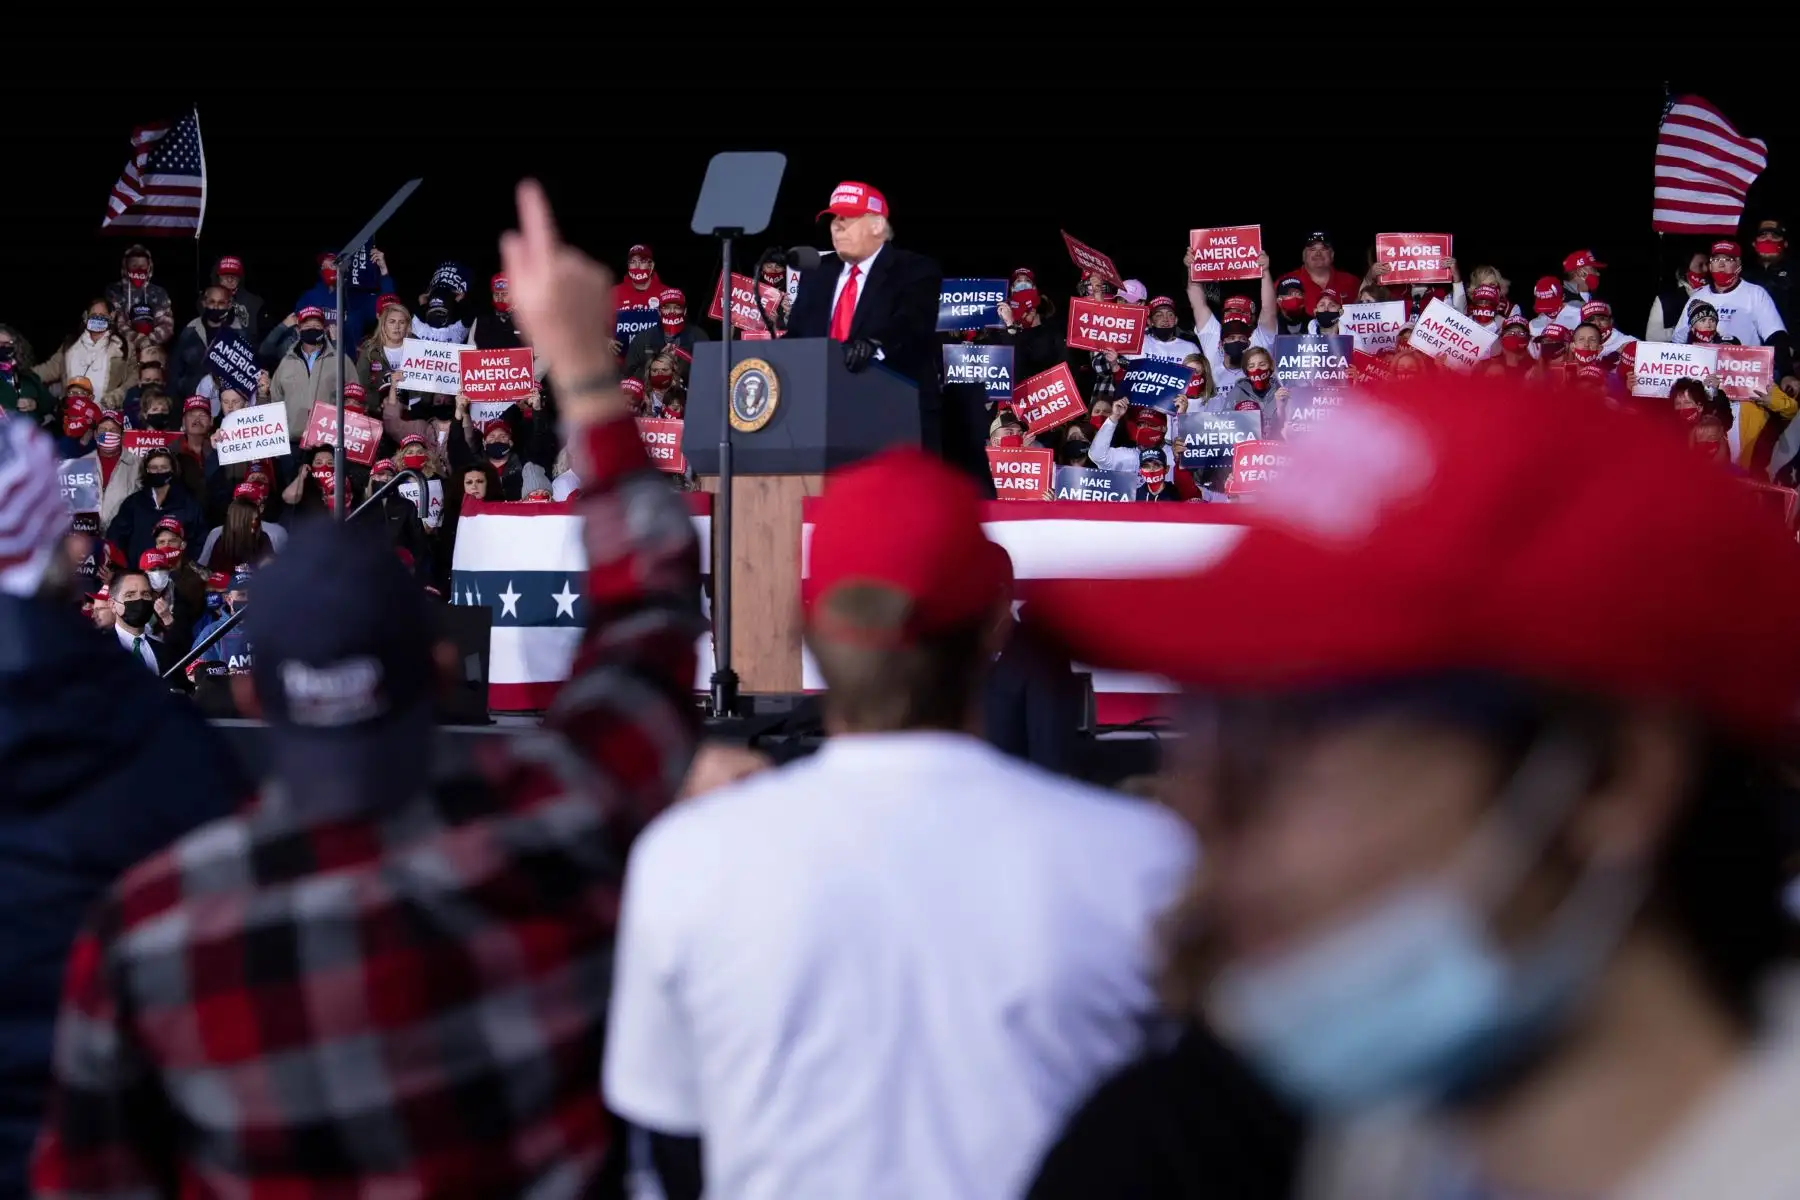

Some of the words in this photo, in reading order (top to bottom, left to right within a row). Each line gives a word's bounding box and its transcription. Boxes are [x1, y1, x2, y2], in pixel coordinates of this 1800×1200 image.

[1210, 236, 1238, 246] MAKE
[1194, 246, 1258, 260] AMERICA
[1386, 247, 1396, 257] 4
[1400, 246, 1441, 256] MORE
[1194, 262, 1224, 271] GREAT
[1228, 261, 1259, 270] AGAIN
[1389, 260, 1440, 271] YEARS!
[940, 292, 1004, 303] ROMISES
[730, 302, 761, 321] ARS!
[952, 304, 985, 316] KEPT
[1353, 312, 1381, 320] MAKE
[662, 317, 684, 325] MAGA
[1080, 313, 1089, 323] 4
[1092, 314, 1136, 330] MORE
[1445, 317, 1472, 337] MAKE
[1346, 322, 1400, 334] MERICA
[1080, 327, 1132, 344] YEARS!
[1371, 336, 1396, 344] AGAI
[1421, 318, 1480, 357] AMERICA
[233, 340, 254, 361] MAKE
[424, 349, 452, 359] MAKE
[1298, 344, 1328, 353] MAKE
[1416, 330, 1445, 349] GREAT
[1445, 347, 1475, 367] AGAIN
[209, 352, 234, 372] GREAT
[214, 340, 262, 380] AMERICA
[480, 357, 510, 366] MAKE
[962, 354, 990, 364] MAKE
[1145, 353, 1182, 362] TRUMP
[1278, 356, 1348, 368] AMERICA
[1661, 352, 1692, 361] MAKE
[404, 358, 460, 373] AMERIC
[947, 365, 1010, 378] AMERICA
[1639, 362, 1710, 377] AMERICA
[1717, 360, 1762, 372] MORE
[402, 371, 433, 381] GREAT
[436, 375, 459, 384] AGAI
[464, 367, 530, 381] AMERICA
[1124, 371, 1186, 389] PROMISES
[1278, 371, 1311, 380] GREAT
[1315, 371, 1349, 380] AGAIN
[232, 372, 256, 392] AGAIN
[464, 383, 496, 392] GREAT
[499, 381, 531, 390] AGAIN
[985, 382, 1010, 390] GAIN
[1638, 377, 1673, 387] GREAT
[1718, 376, 1759, 388] EARS!
[1019, 398, 1027, 409] 4
[1027, 380, 1066, 406] MORE
[1131, 382, 1164, 396] KEPT
[1024, 395, 1071, 424] YEARS!
[237, 414, 264, 426] MAKE
[318, 416, 328, 428] 4
[1204, 420, 1236, 430] MAKE
[222, 422, 284, 442] AMERICA
[136, 437, 164, 446] MAKE
[256, 436, 286, 448] AGAIN
[1184, 432, 1256, 446] AMERICA
[222, 442, 252, 454] GREAT
[652, 448, 674, 459] RS!
[1184, 448, 1220, 458] GREAT
[1240, 456, 1248, 466] 4
[1252, 454, 1288, 467] MOR
[996, 462, 1041, 474] MORE
[64, 473, 94, 486] ISES
[994, 478, 1039, 490] EARS!
[1080, 477, 1111, 488] MAKE
[61, 488, 76, 498] PT
[1058, 488, 1129, 502] AMERICA
